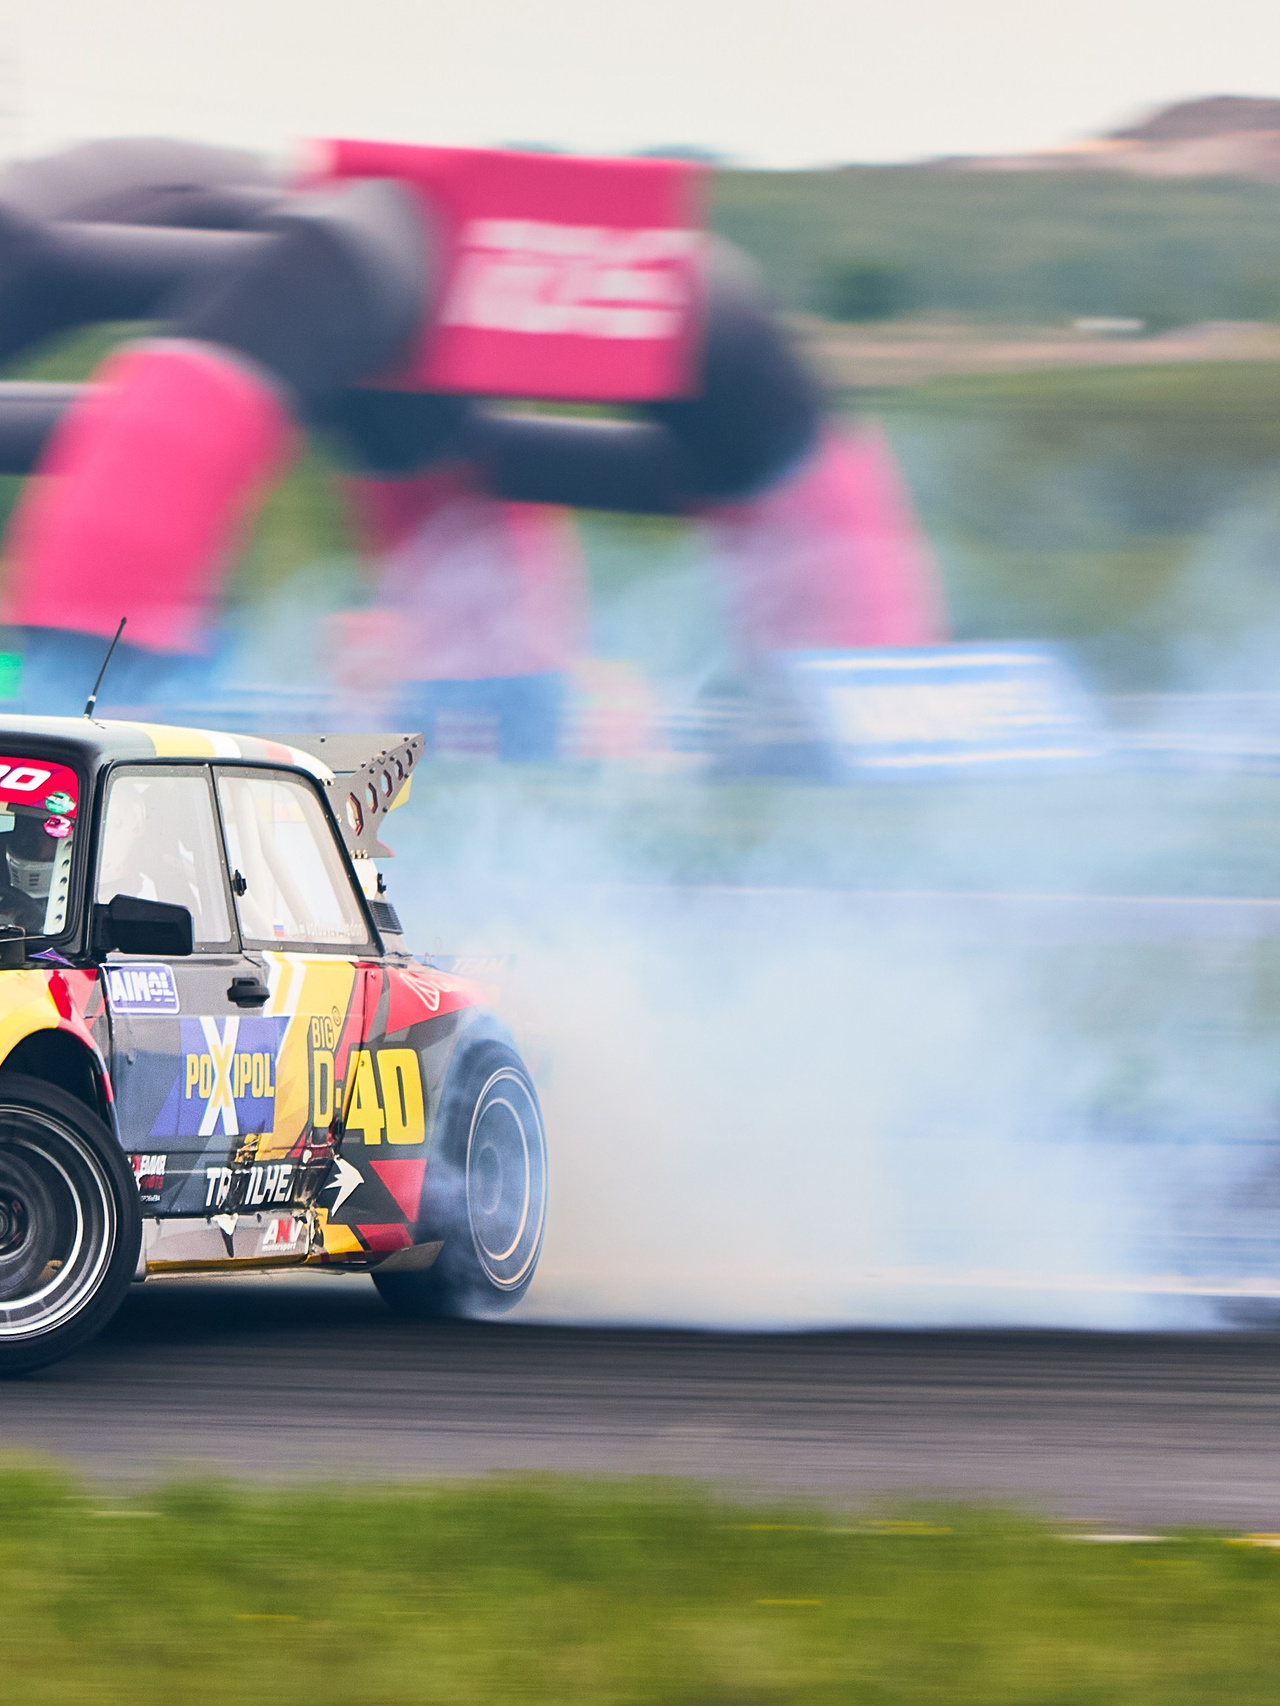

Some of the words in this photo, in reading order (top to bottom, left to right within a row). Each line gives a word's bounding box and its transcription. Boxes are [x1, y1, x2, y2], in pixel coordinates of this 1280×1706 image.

[111, 971, 176, 1003] AIMOL
[311, 1016, 335, 1050] BIG
[185, 1016, 275, 1136] POXIPOL
[313, 1048, 425, 1145] D-40
[262, 1218, 304, 1245] ANV
